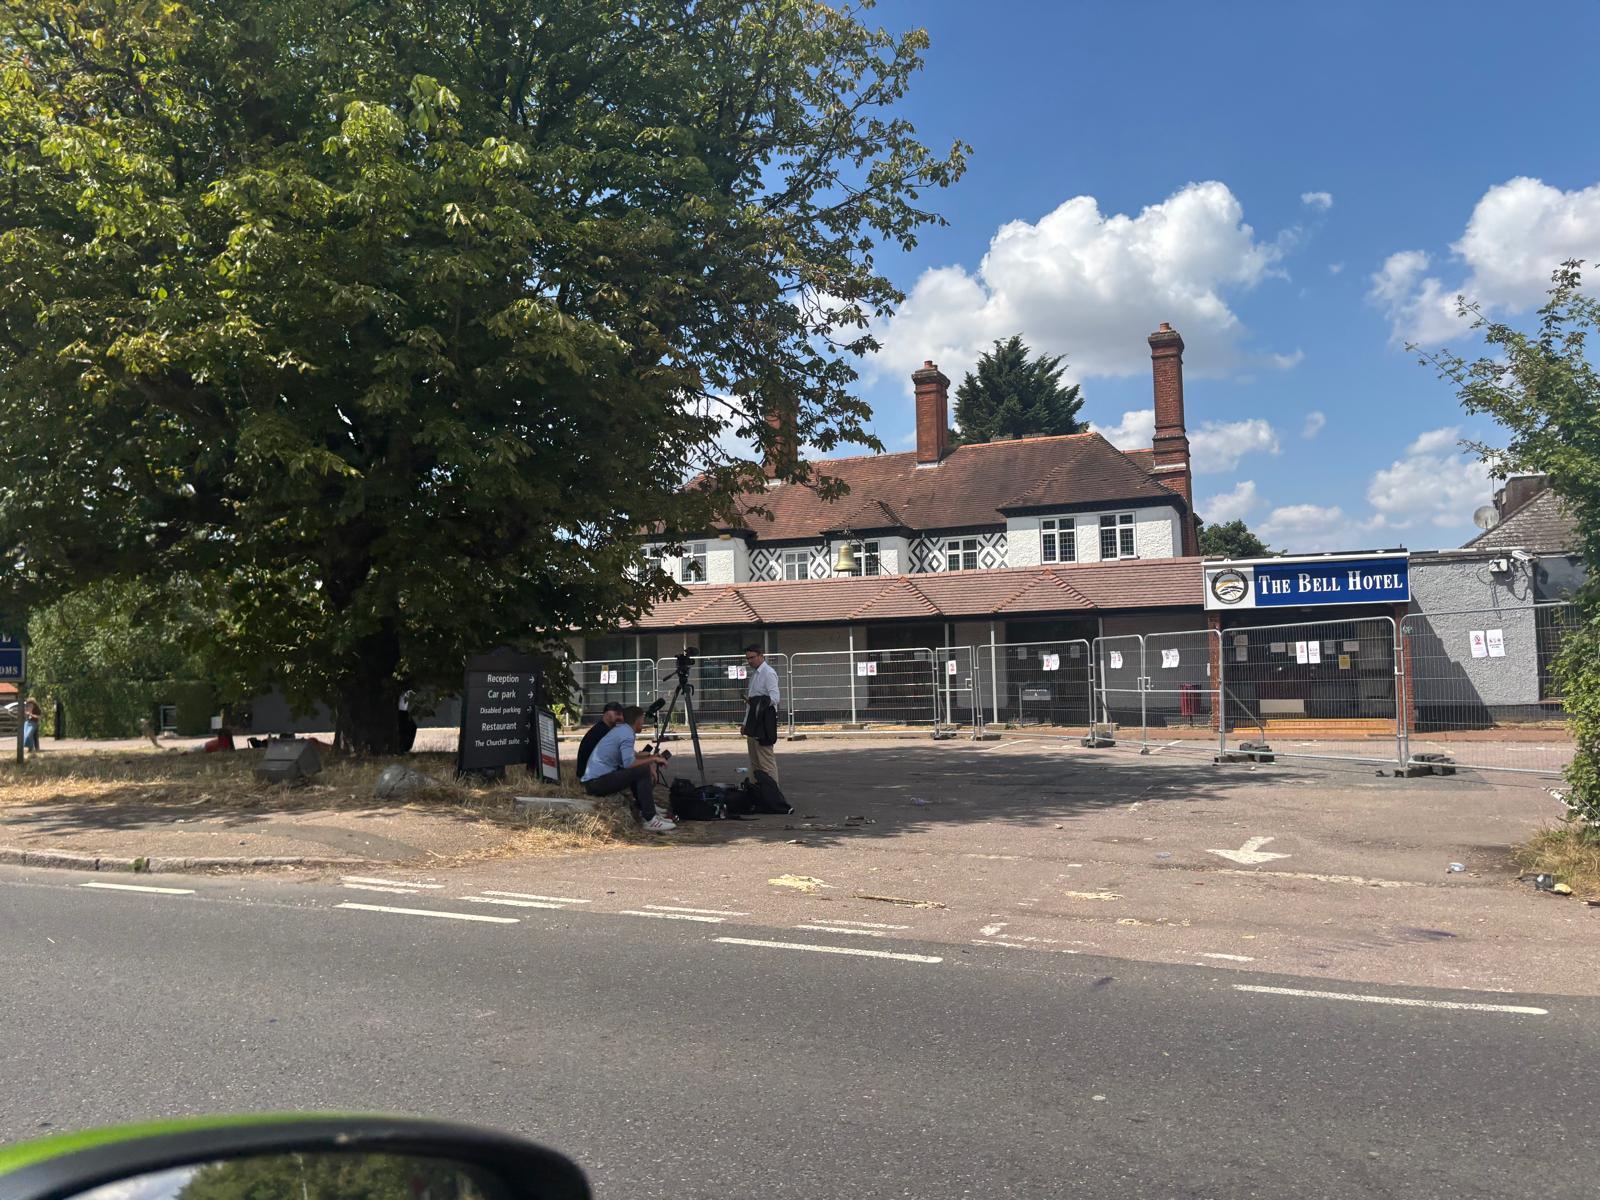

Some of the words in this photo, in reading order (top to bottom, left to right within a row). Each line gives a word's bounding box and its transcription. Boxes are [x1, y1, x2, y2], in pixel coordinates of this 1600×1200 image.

[1258, 575, 1291, 595] THE
[1298, 572, 1341, 593] BELL
[1347, 570, 1403, 591] HOTEL
[487, 674, 520, 685] Reception
[487, 689, 499, 699] Car
[501, 689, 516, 700] park
[480, 706, 502, 714] Disabled
[502, 706, 521, 715] parking
[481, 722, 517, 731] Restaurant
[486, 738, 507, 746] Churchill
